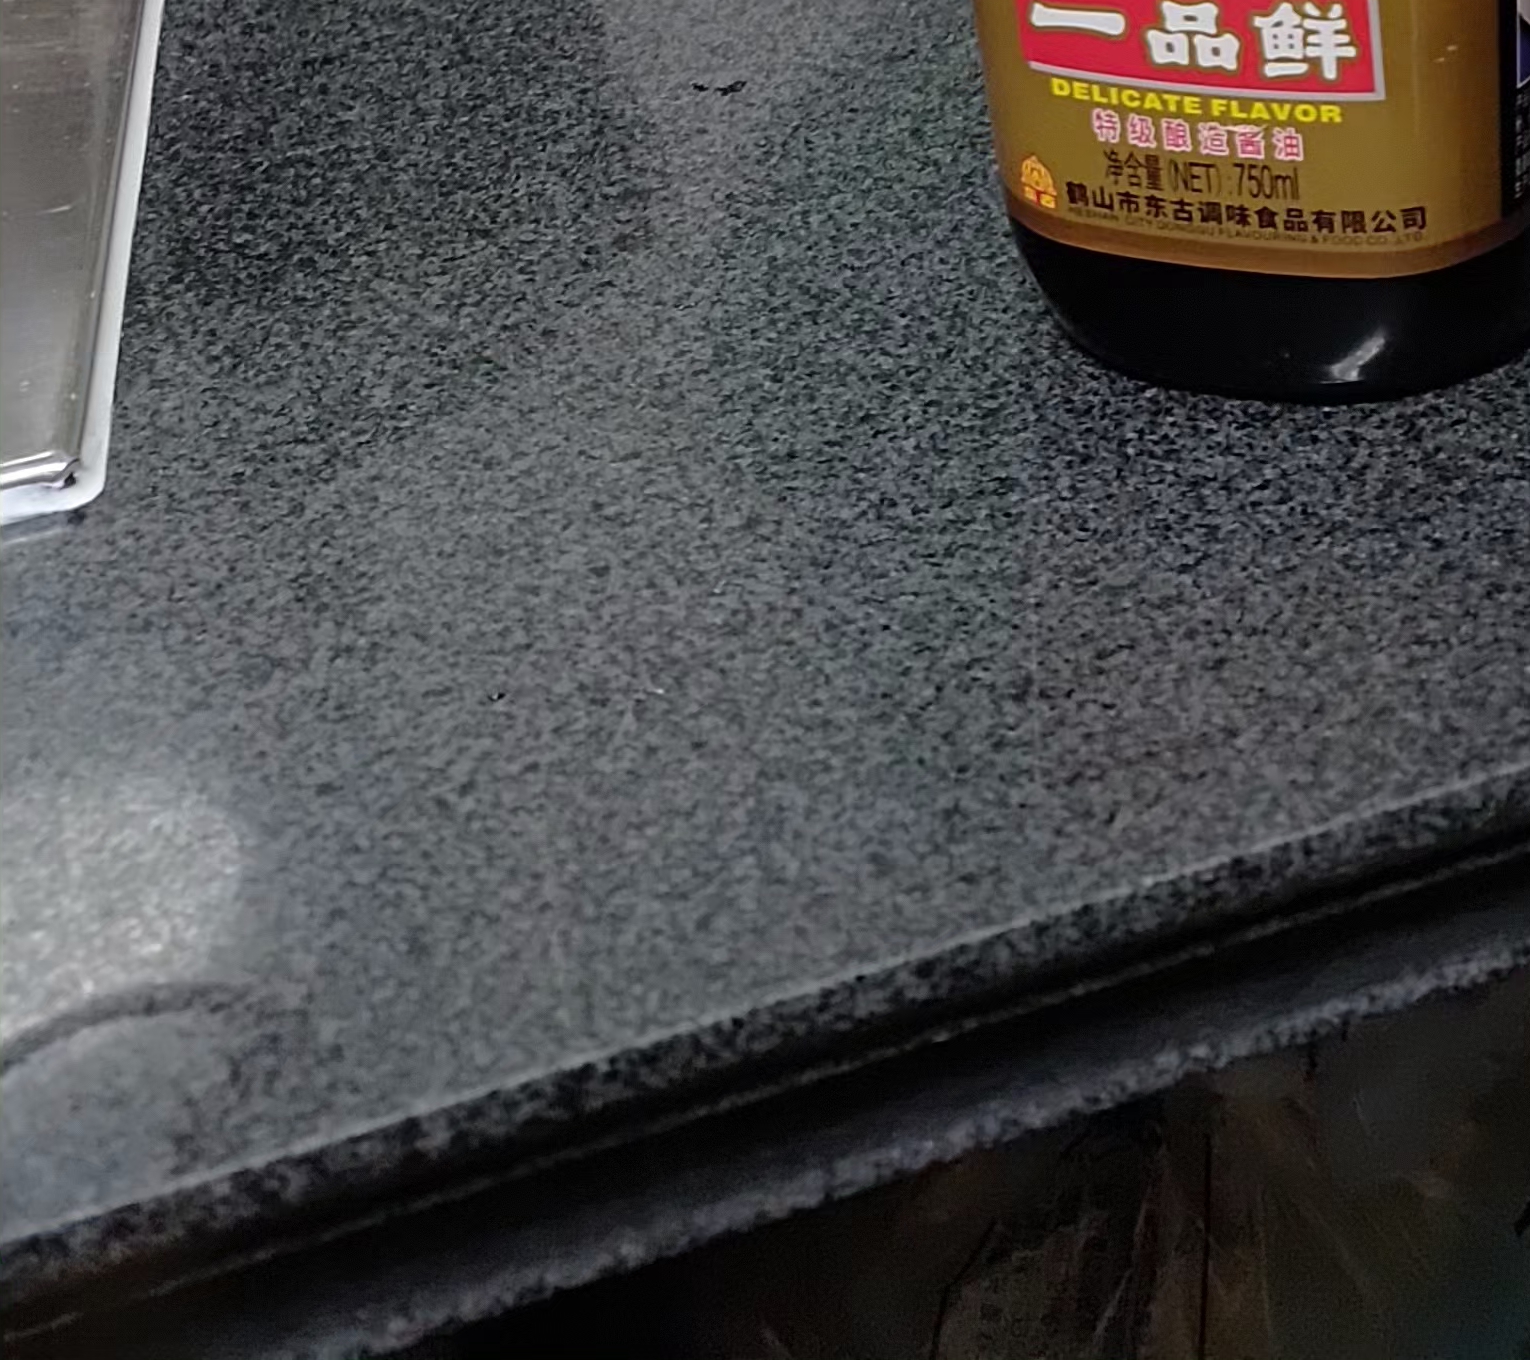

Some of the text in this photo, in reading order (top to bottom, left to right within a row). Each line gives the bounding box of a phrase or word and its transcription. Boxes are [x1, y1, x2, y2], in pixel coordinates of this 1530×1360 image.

[1051, 77, 1343, 123] DELICATE FLAVOR
[1092, 107, 1305, 162] 特级酿造酱油
[1065, 180, 1428, 234] 鹤山市东古调味食品有限公司
